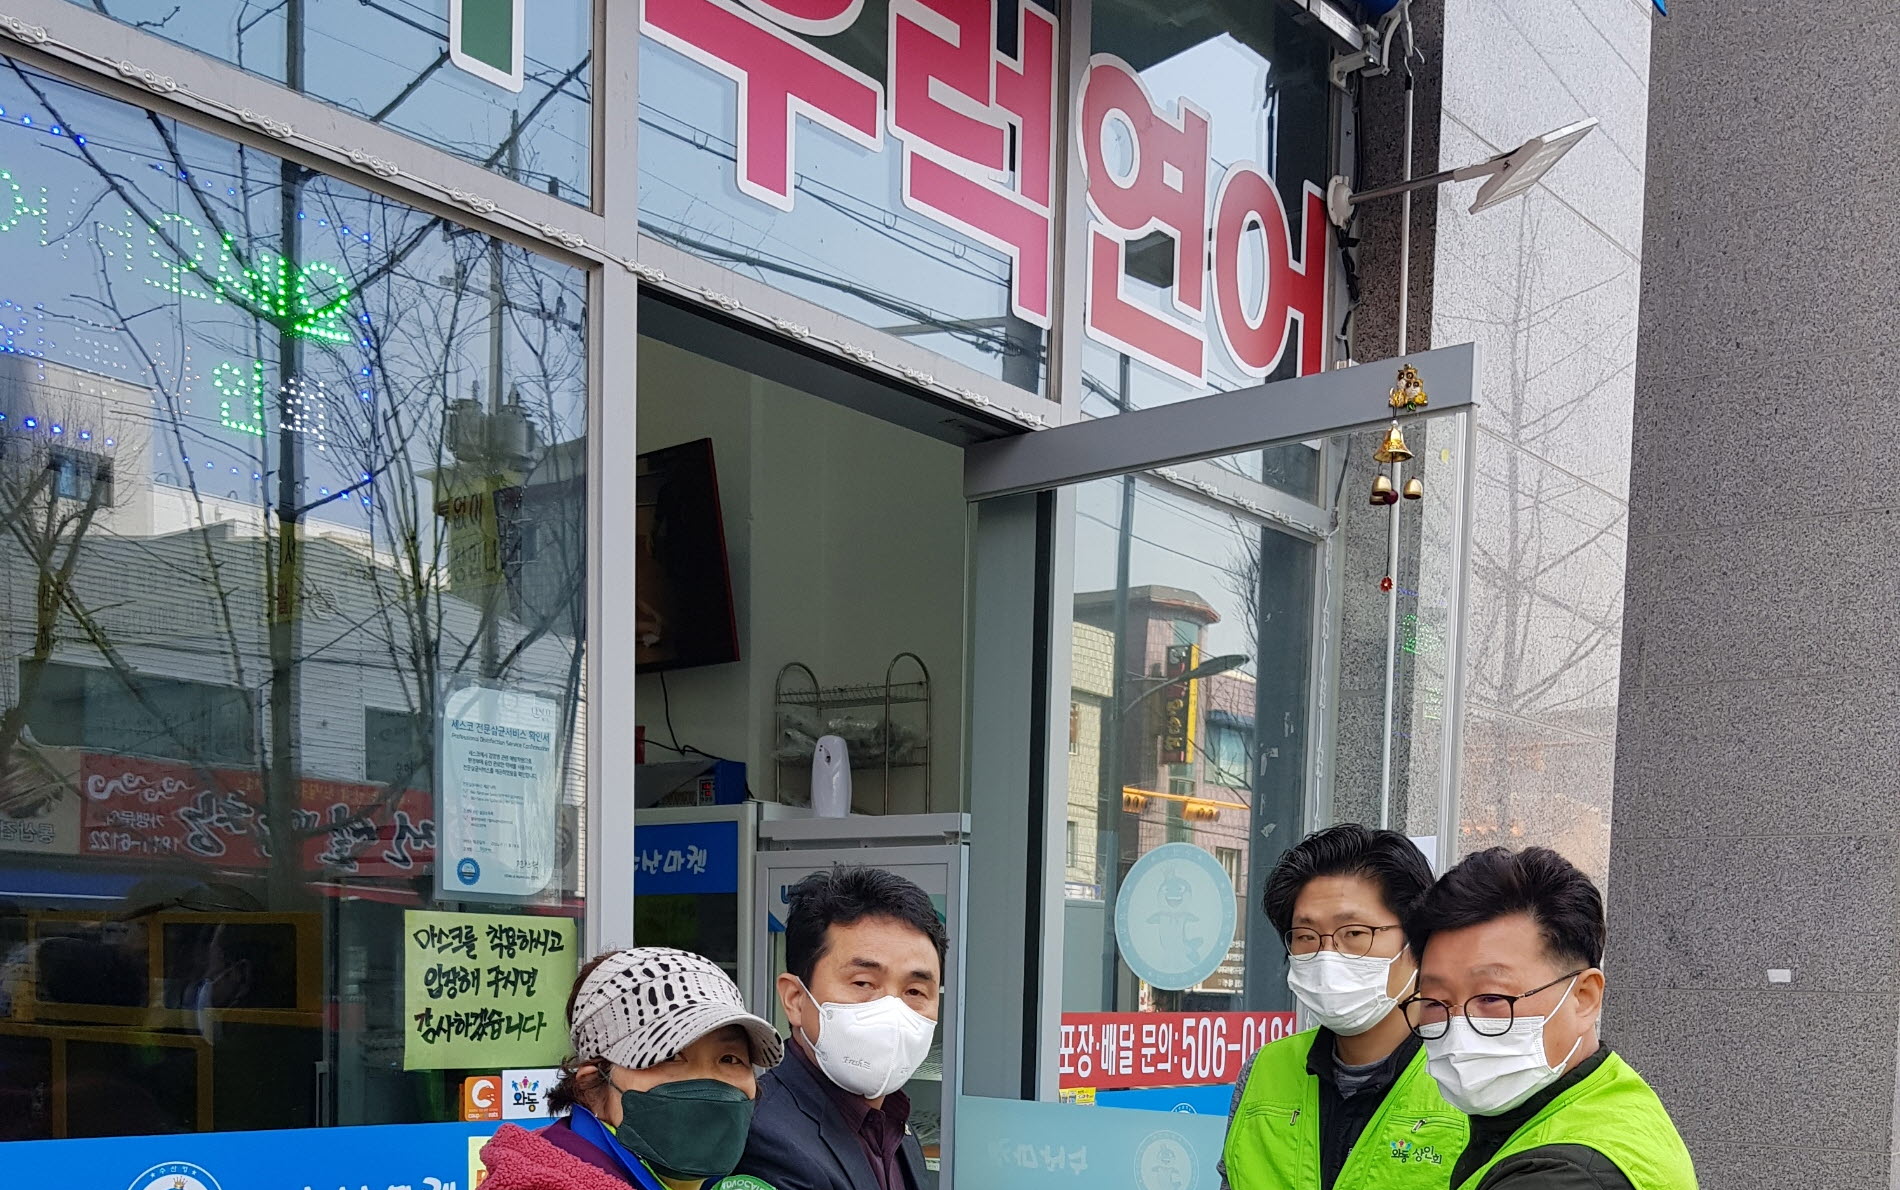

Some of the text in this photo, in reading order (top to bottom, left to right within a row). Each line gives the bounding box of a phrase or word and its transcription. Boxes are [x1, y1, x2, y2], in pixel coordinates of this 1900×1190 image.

[1077, 52, 1330, 388] 연어
[412, 923, 565, 960] 마스크를 착용하시고
[423, 963, 539, 1000] 입장해 주시면
[413, 1006, 548, 1045] 감사하겠습니다
[512, 1091, 540, 1113] 와동
[1390, 1145, 1443, 1165] 와동 상인회
